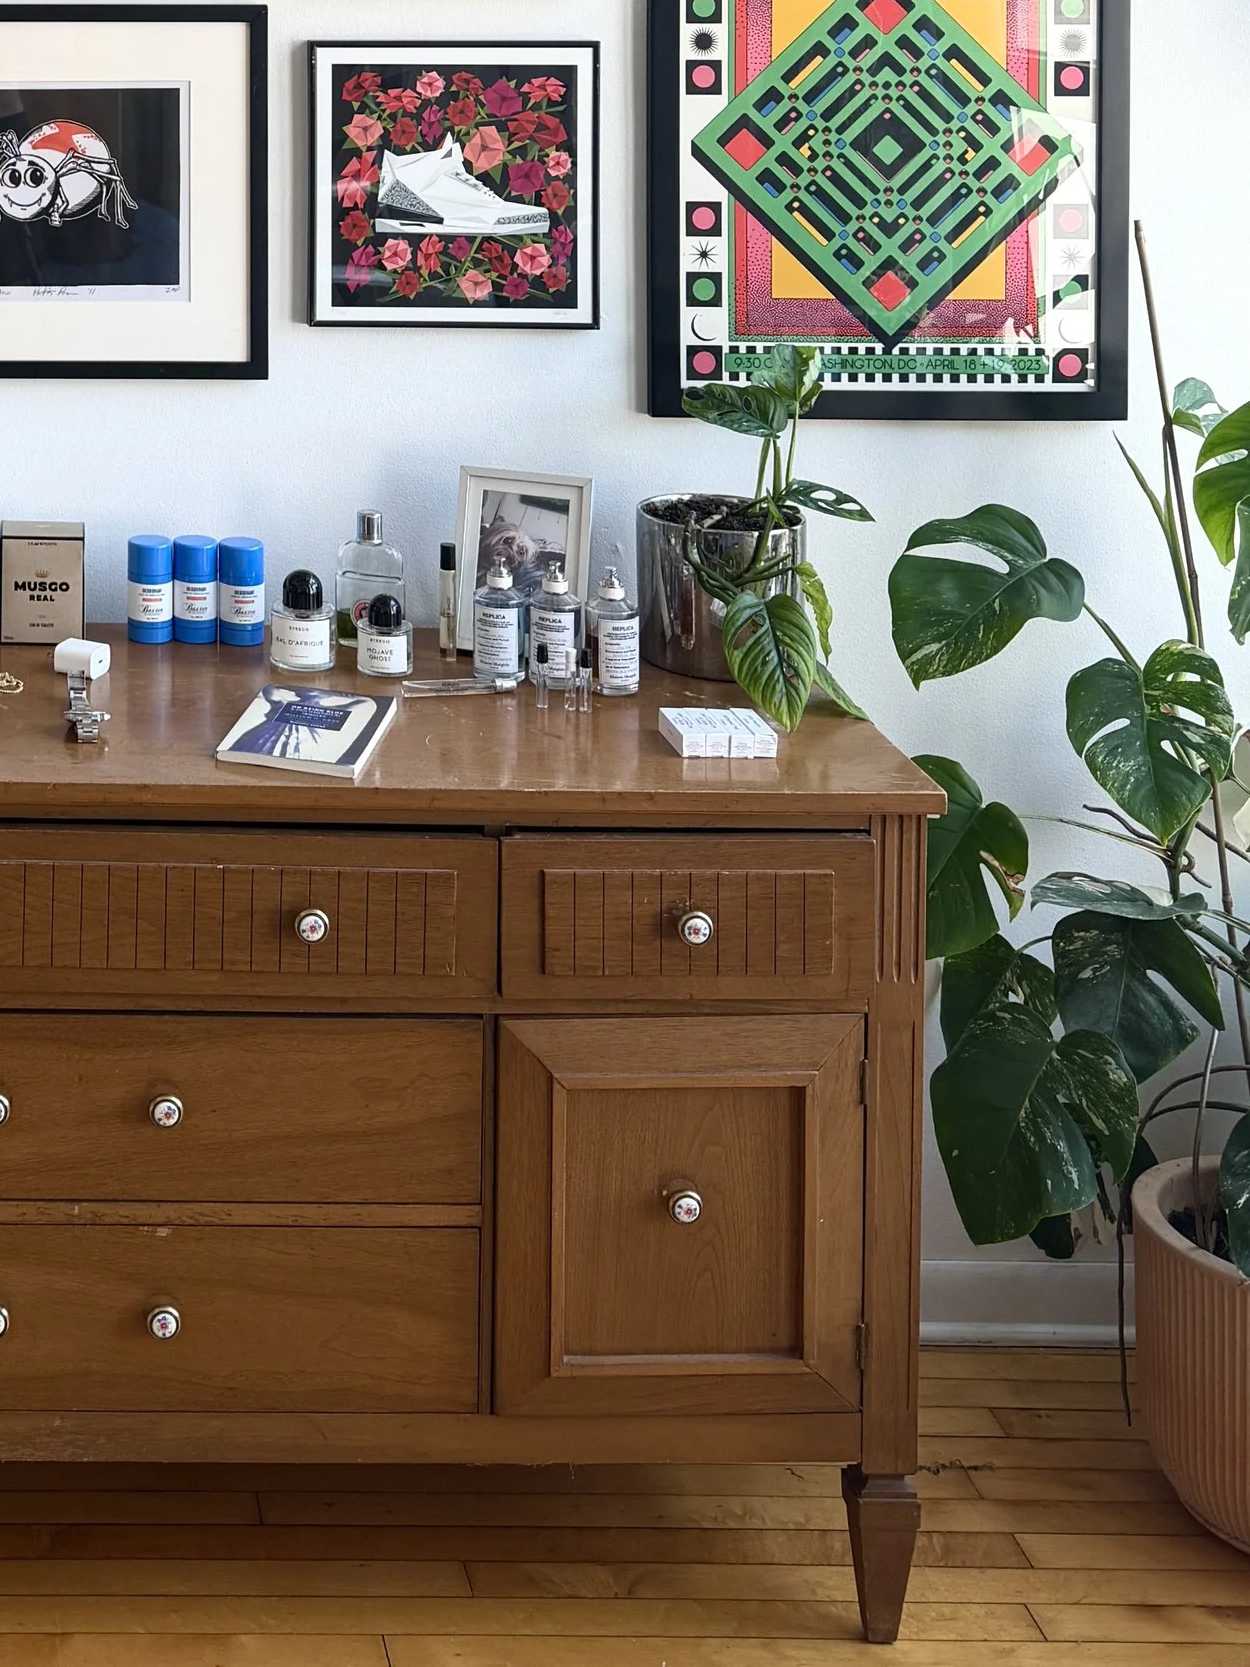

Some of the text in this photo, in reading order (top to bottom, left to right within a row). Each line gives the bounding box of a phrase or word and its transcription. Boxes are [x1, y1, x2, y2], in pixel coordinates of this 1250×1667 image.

[820, 357, 895, 371] ASHINGTON,
[897, 357, 918, 370] DC
[925, 357, 960, 371] APRIL
[963, 358, 977, 370] 18
[1011, 358, 1042, 371] 2023
[13, 580, 71, 592] MUSGO
[28, 594, 56, 602] REAL
[482, 612, 506, 620] REPLICA
[538, 616, 562, 624] REPLICA
[288, 638, 324, 647] D'AFRIQUE
[366, 647, 394, 656] MOJAVE
[368, 654, 392, 662] GHOST
